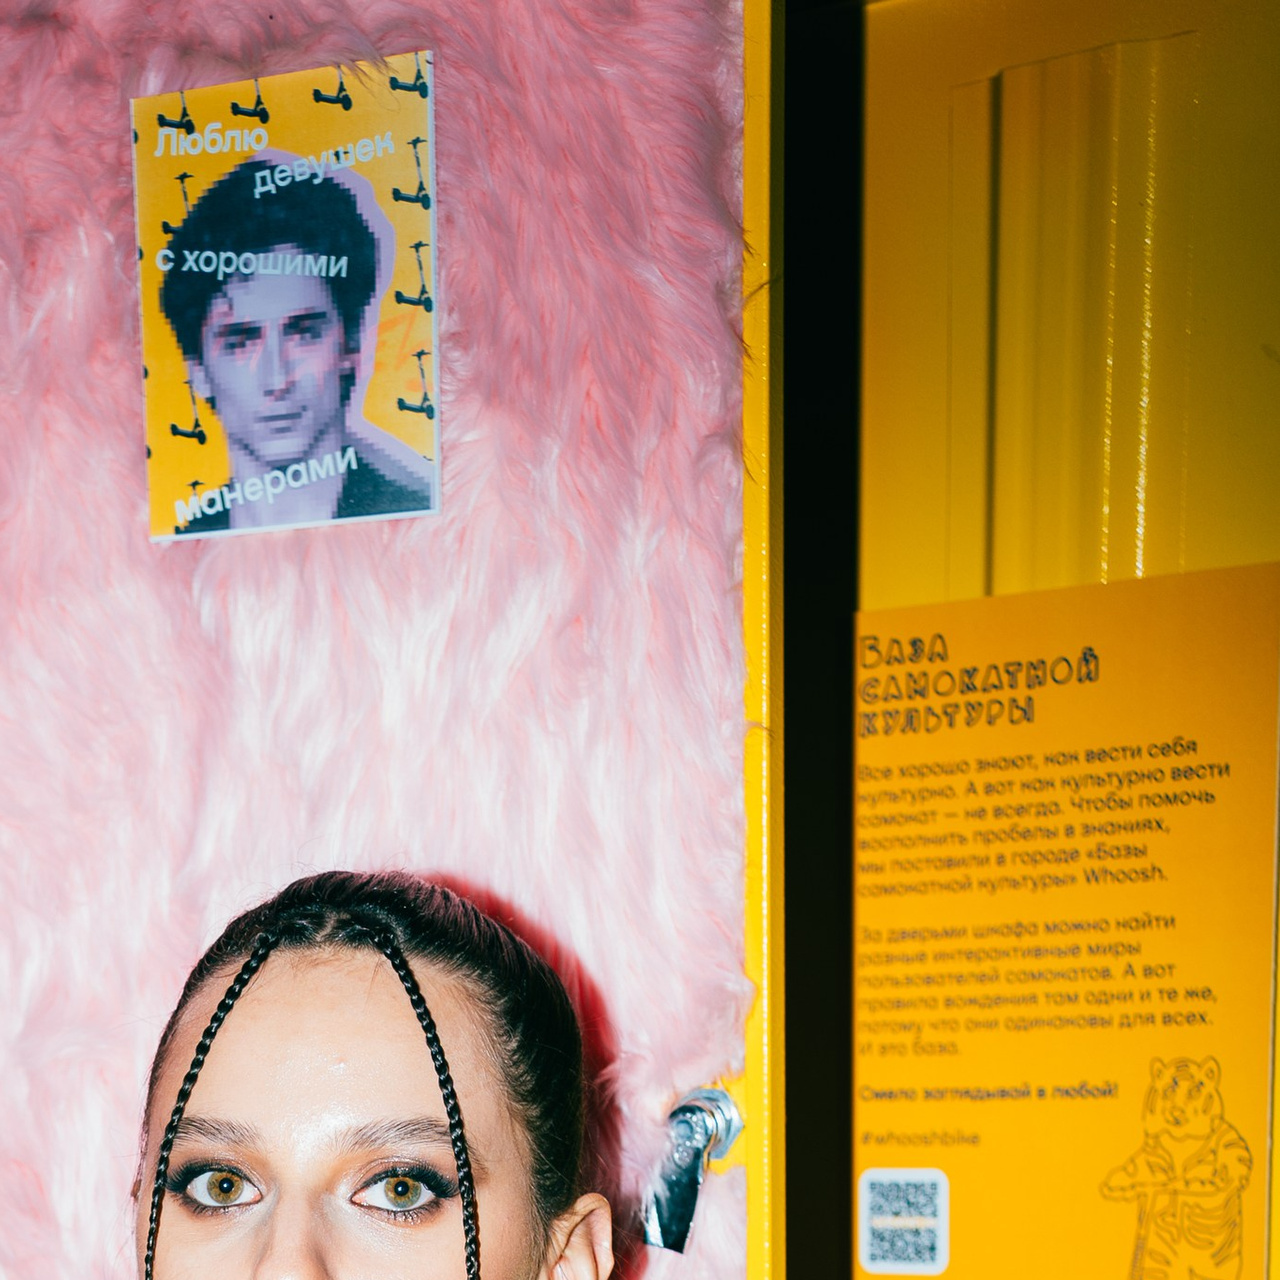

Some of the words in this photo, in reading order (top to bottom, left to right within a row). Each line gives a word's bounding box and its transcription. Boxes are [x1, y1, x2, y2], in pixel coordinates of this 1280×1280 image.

[155, 122, 269, 158] Люблю
[253, 129, 395, 198] девушек
[155, 247, 175, 270] с
[181, 249, 348, 280] хорошими
[174, 446, 358, 524] манерами
[858, 633, 949, 669] БАЗА
[858, 647, 1099, 704] САМОКАТНОЙ
[858, 697, 1034, 738] КУЛЬТУРЫ
[858, 764, 893, 781] Все
[898, 758, 971, 780] хорошо
[975, 755, 1038, 774] знают,
[1044, 750, 1080, 767] как
[1085, 744, 1142, 764] вести
[1147, 736, 1197, 759] себя
[965, 781, 978, 797] А
[984, 779, 1014, 795] вот
[1021, 776, 1056, 792] как
[1061, 767, 1166, 791] культурно
[1171, 762, 1230, 781] вести
[858, 809, 938, 828] самокат
[964, 806, 987, 821] не
[1071, 792, 1133, 812] Чтобы
[1138, 789, 1215, 807] помочь
[858, 833, 968, 852] восполнить
[972, 824, 1059, 849] пробелы
[1064, 824, 1076, 837] в
[1080, 818, 1170, 837] знаниях,
[892, 852, 990, 874] поставили
[1011, 848, 1080, 867] городе
[1087, 843, 1147, 861] «Базы
[858, 875, 972, 897] самокатной
[1084, 863, 1168, 885] Whoosh.
[1044, 918, 1109, 934] можно
[1114, 913, 1176, 930] найти
[1086, 940, 1140, 958] миры
[1005, 967, 1116, 983] самокатов.
[1123, 964, 1136, 979] А
[1143, 963, 1175, 979] вот
[1044, 991, 1078, 1006] там
[1085, 990, 1134, 1007] одни
[1139, 988, 1151, 1002] и
[1158, 987, 1179, 1002] те
[1118, 1012, 1155, 1029] для
[1161, 1011, 1213, 1026] всех.
